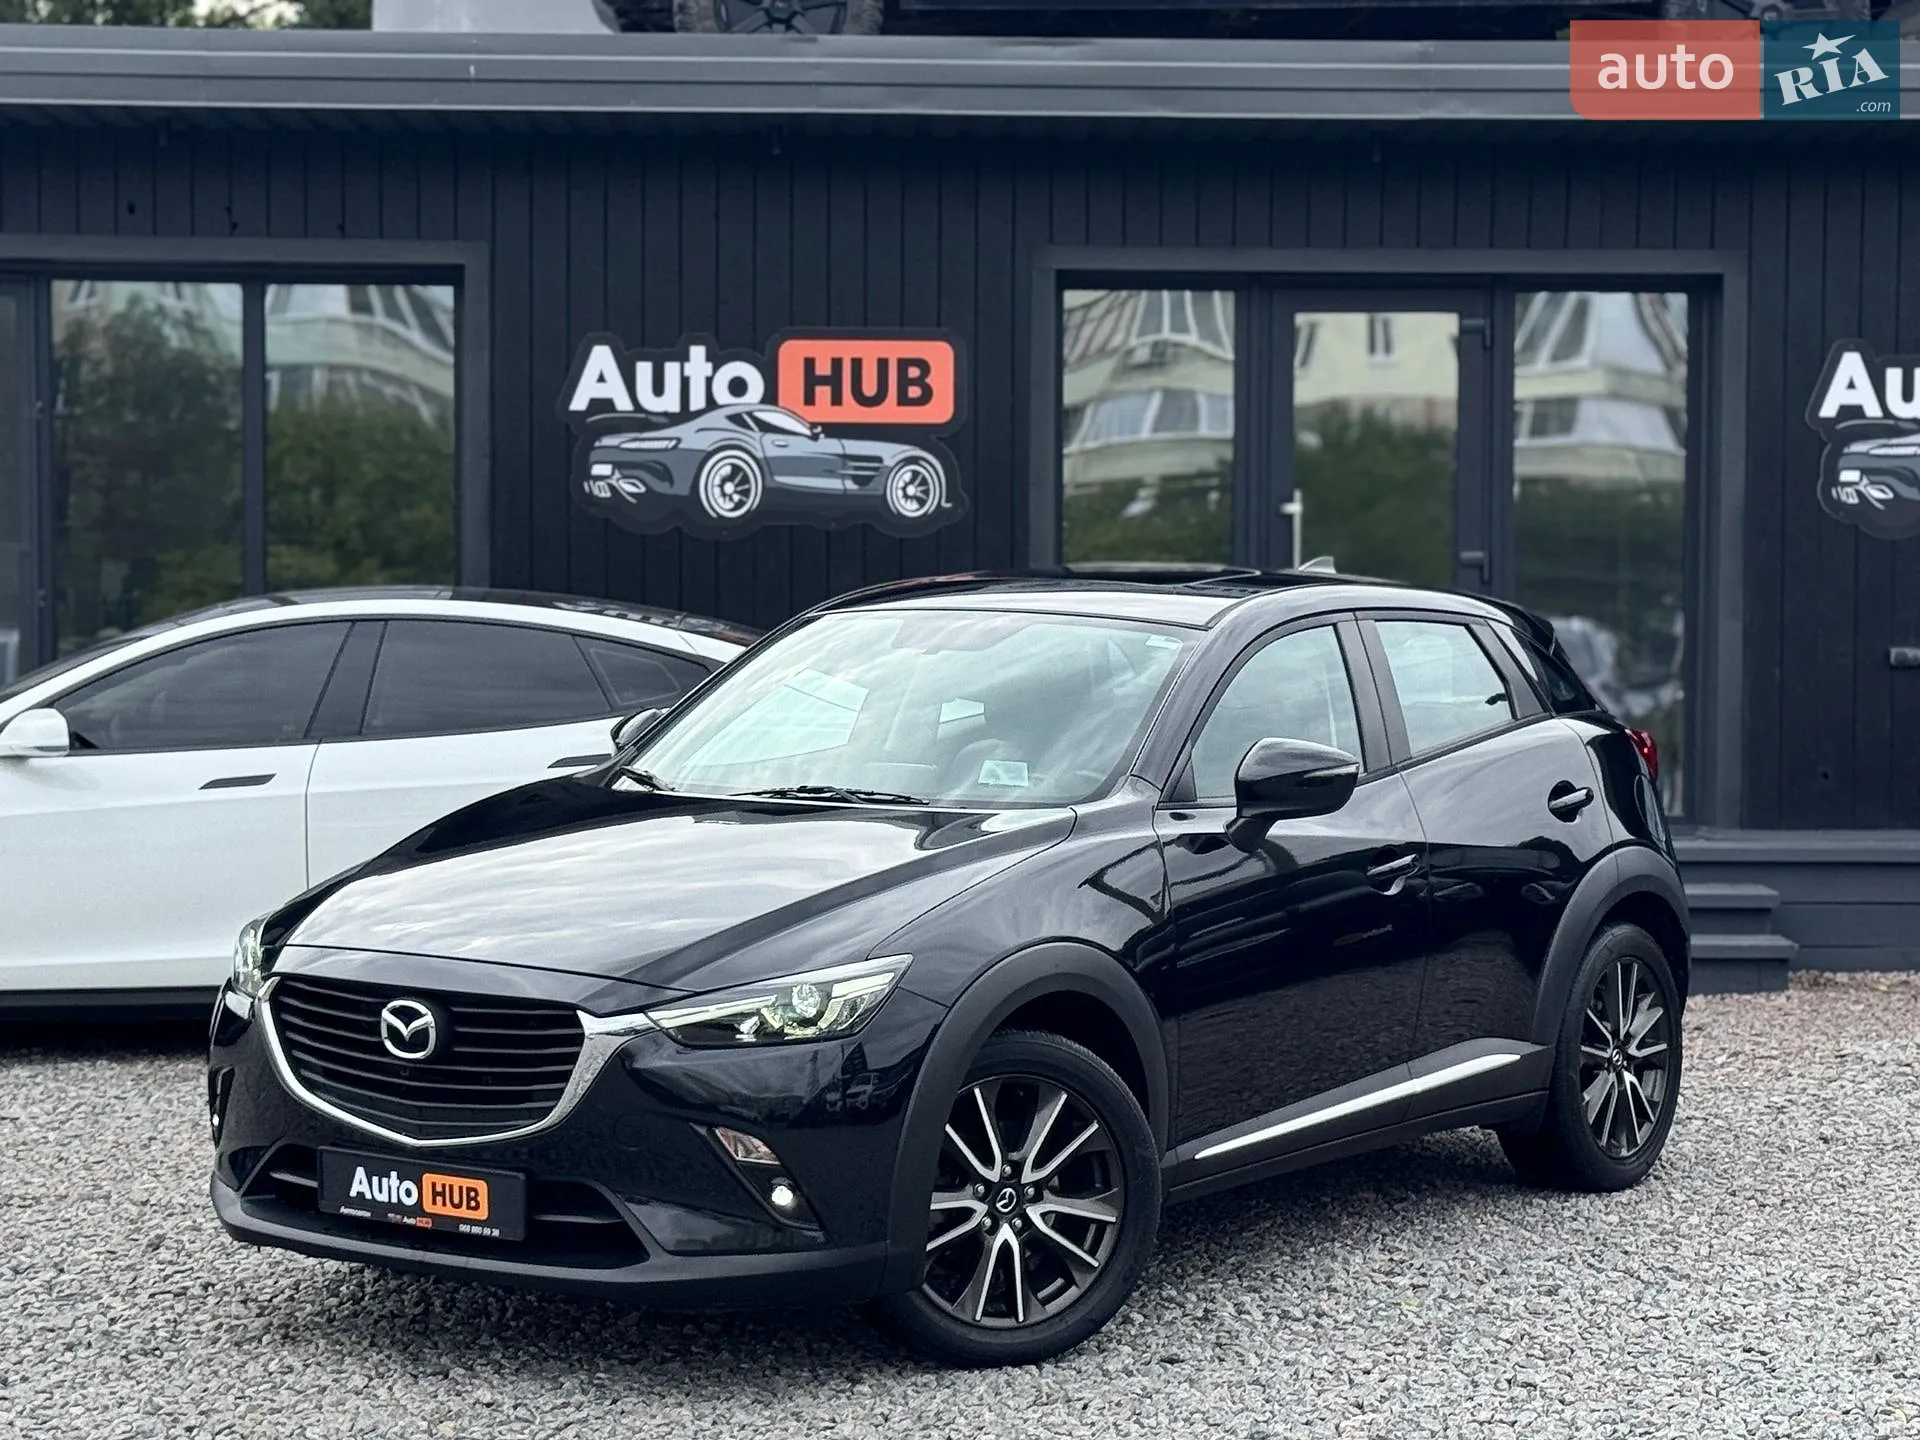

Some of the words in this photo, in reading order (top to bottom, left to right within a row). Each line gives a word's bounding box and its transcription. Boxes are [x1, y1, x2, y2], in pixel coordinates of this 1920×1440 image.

[569, 345, 765, 412] Auto
[803, 357, 934, 408] HUB
[350, 1166, 419, 1206] Auto
[431, 1181, 480, 1211] HUB
